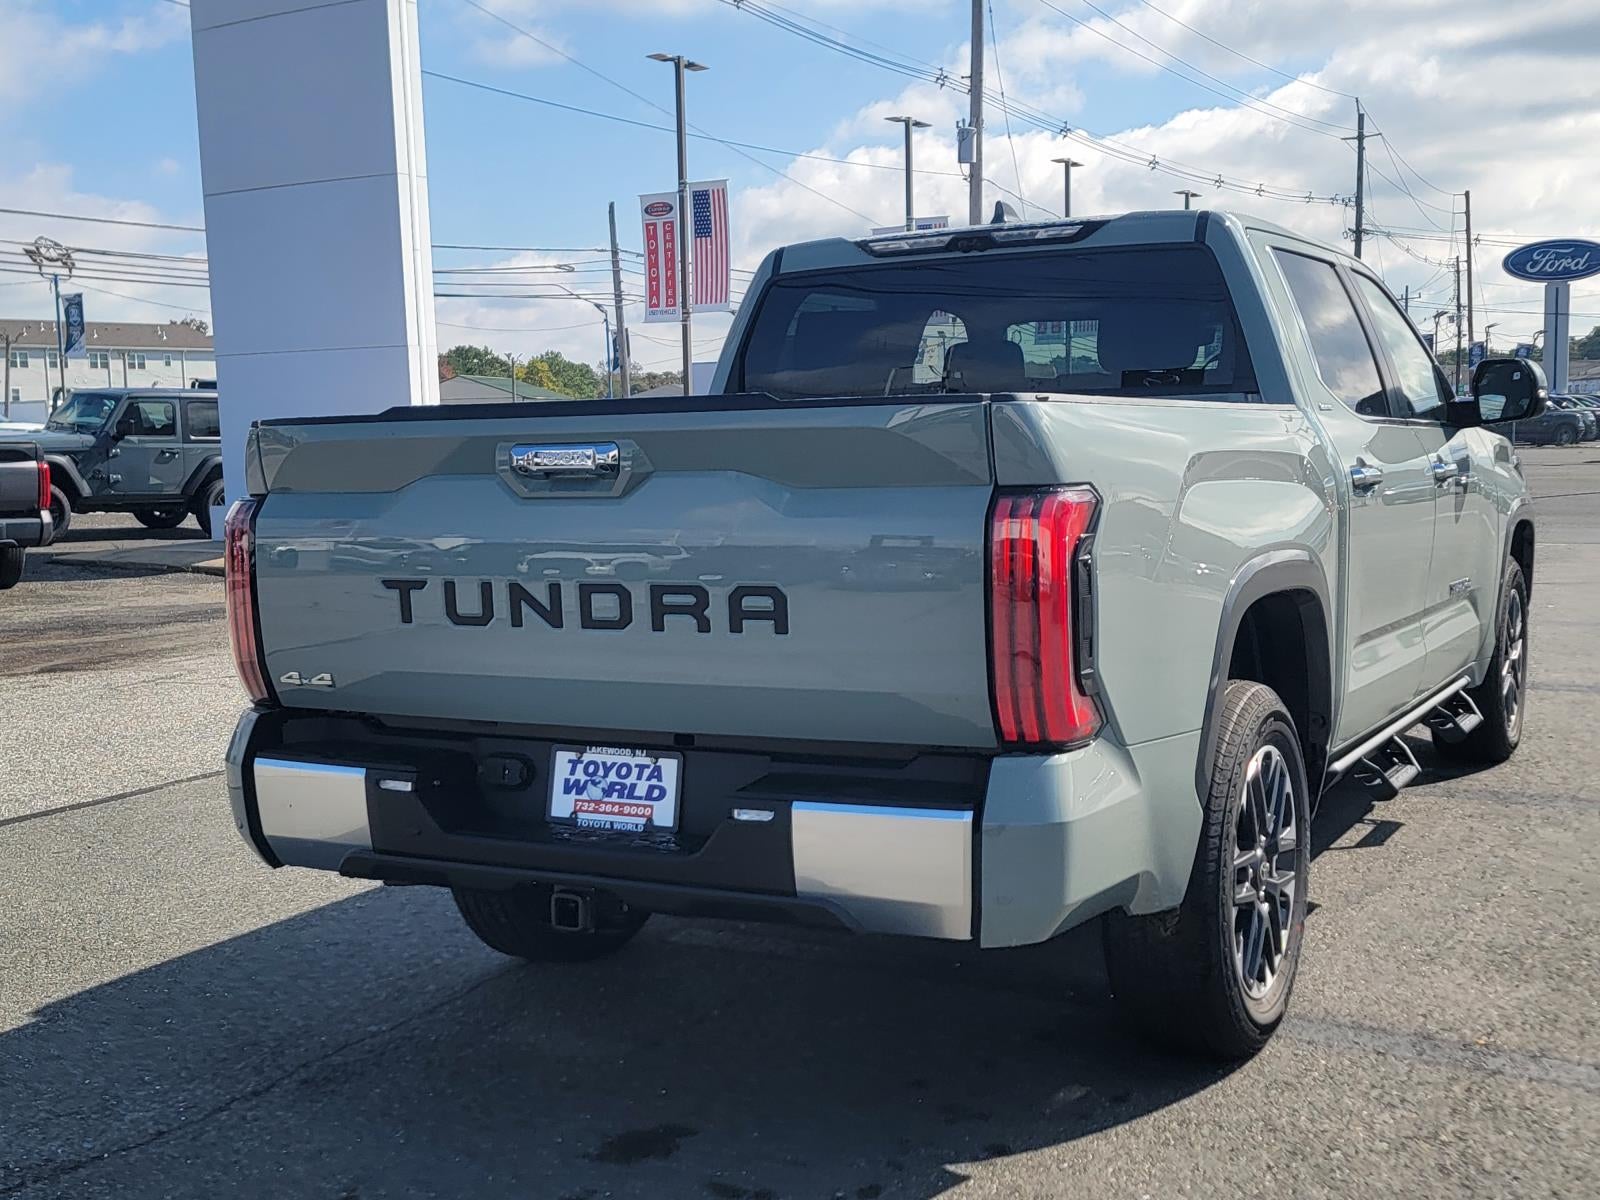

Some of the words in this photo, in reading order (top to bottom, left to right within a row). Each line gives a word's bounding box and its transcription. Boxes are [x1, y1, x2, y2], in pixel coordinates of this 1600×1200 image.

[648, 226, 658, 305] TOYOTA
[665, 223, 674, 305] CERTIFIED
[1526, 247, 1591, 273] Ford
[382, 579, 789, 634] TUNDRA
[587, 746, 634, 757] LAKEWOOD,
[635, 749, 647, 757] NJ
[567, 759, 663, 782] TOYOTA
[563, 777, 667, 801] WORLD
[575, 801, 652, 816] 732-364-9000
[577, 819, 611, 830] TOYOTA
[613, 821, 644, 832] WORLD
